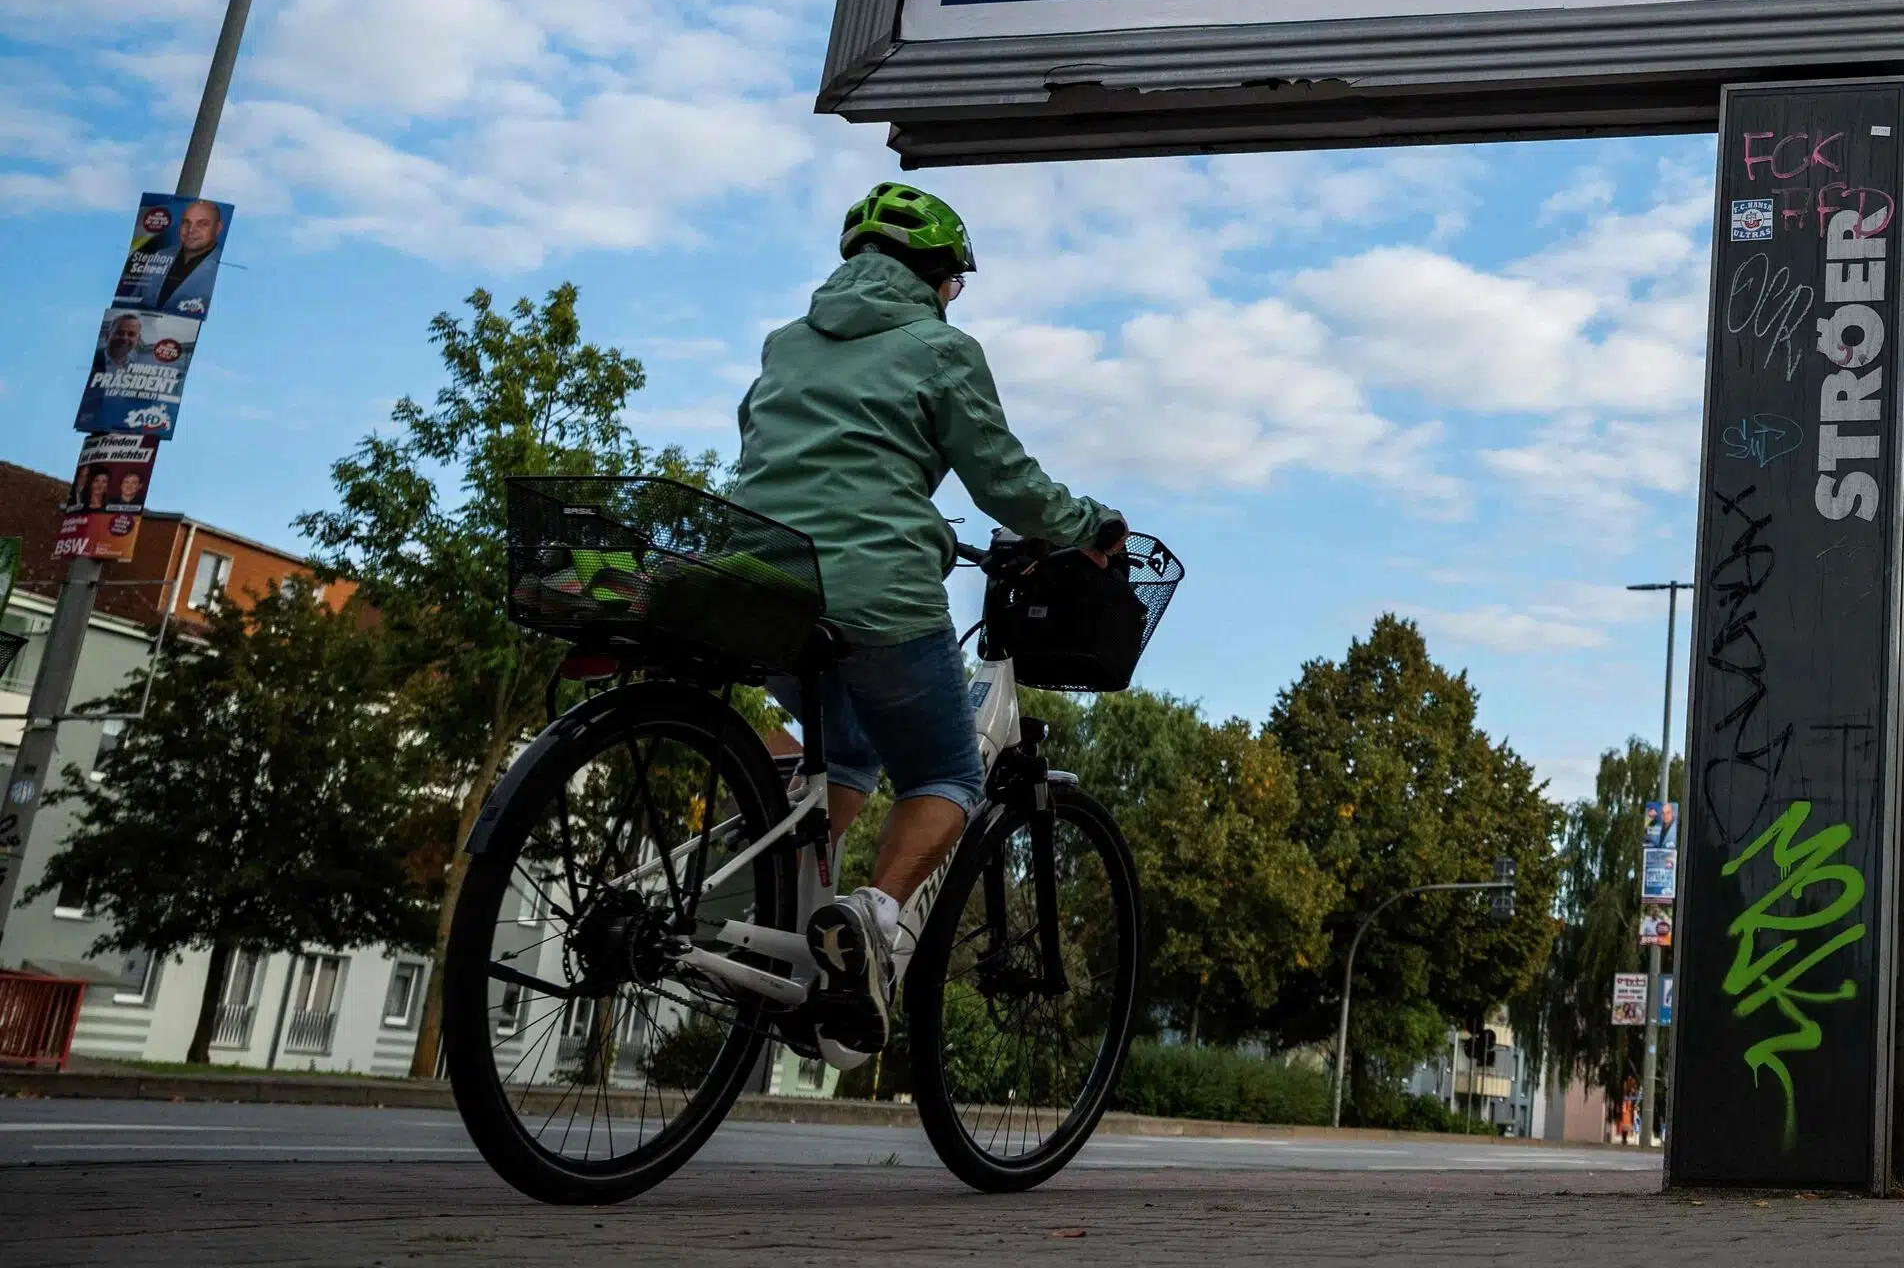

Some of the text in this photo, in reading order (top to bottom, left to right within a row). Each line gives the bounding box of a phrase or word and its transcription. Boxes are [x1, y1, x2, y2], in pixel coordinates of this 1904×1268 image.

[1743, 131, 1845, 181] FCK
[1733, 227, 1771, 239] ULTRAS
[131, 251, 174, 266] Stephan
[1814, 205, 1889, 523] STRÖER
[90, 369, 179, 394] PRÄSIDENT
[135, 413, 161, 425] AfD
[100, 436, 138, 448] Frieden
[110, 450, 149, 461] nichts!
[54, 537, 90, 555] BSW
